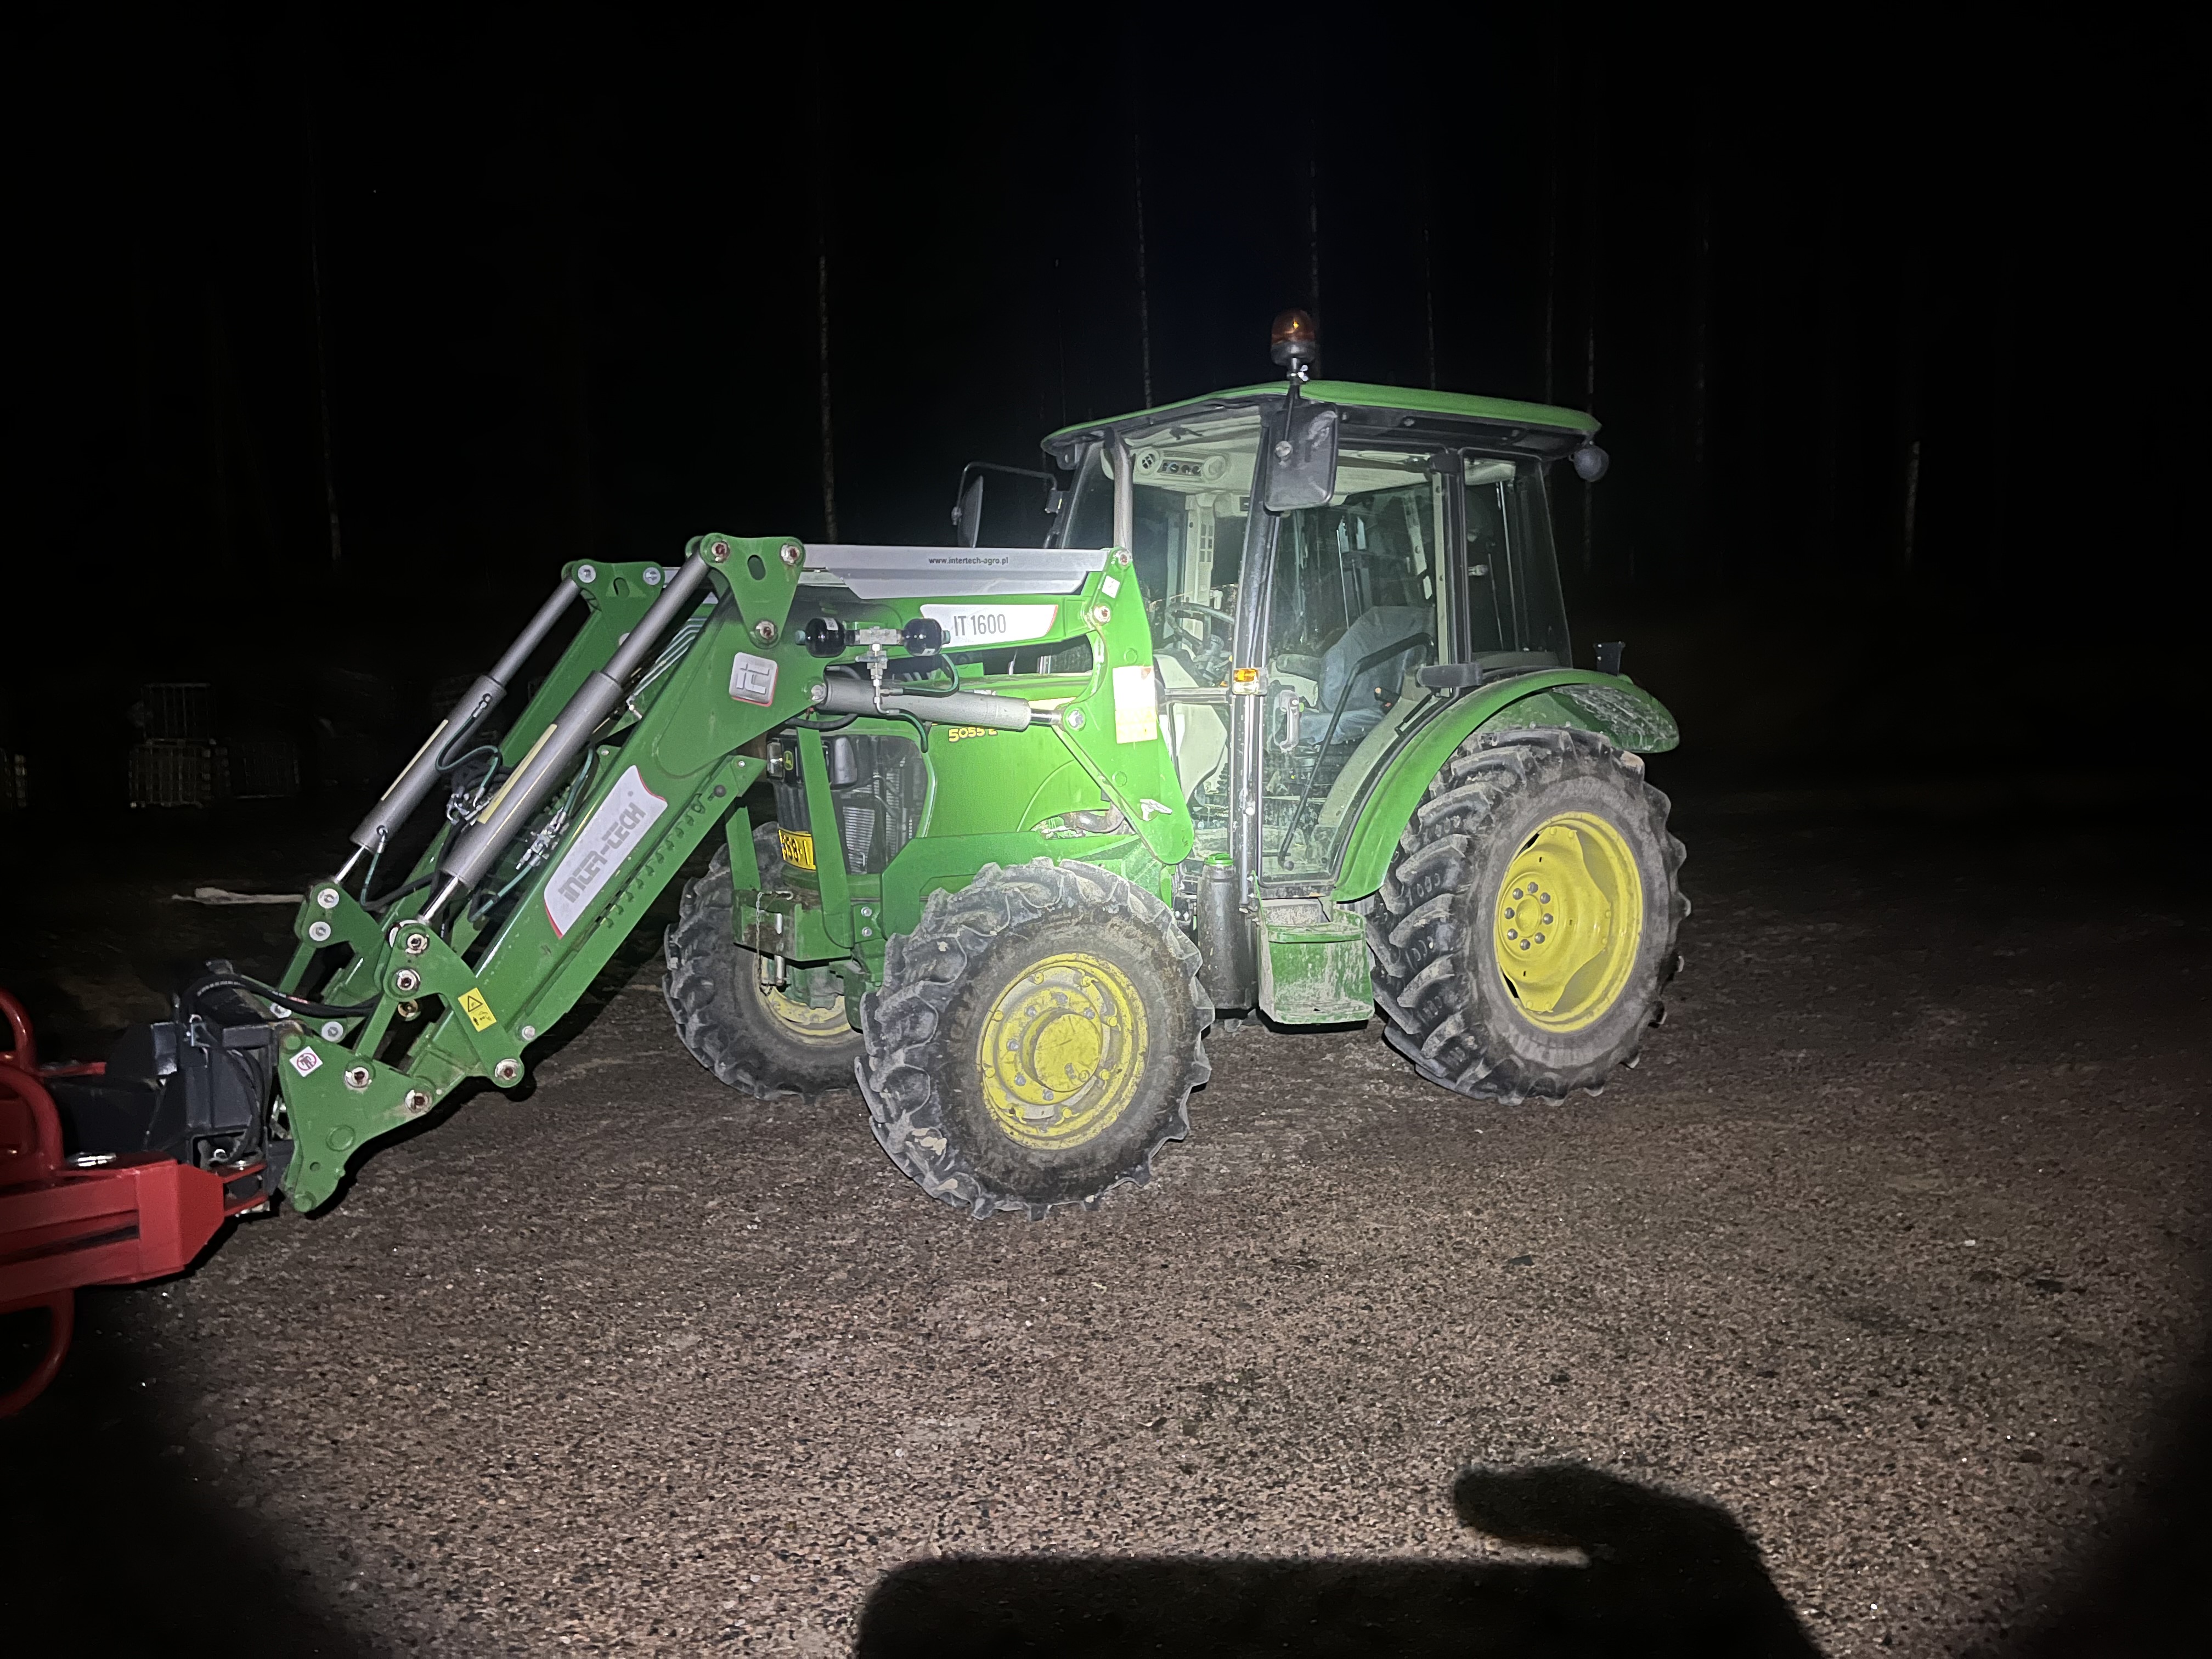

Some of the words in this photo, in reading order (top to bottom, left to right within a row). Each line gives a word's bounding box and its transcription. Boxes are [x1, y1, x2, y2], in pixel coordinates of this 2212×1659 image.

[928, 556, 1008, 566] www.intertech-agro.pl
[954, 615, 970, 637] IT
[973, 613, 1006, 635] 1600
[949, 726, 985, 742] 5055
